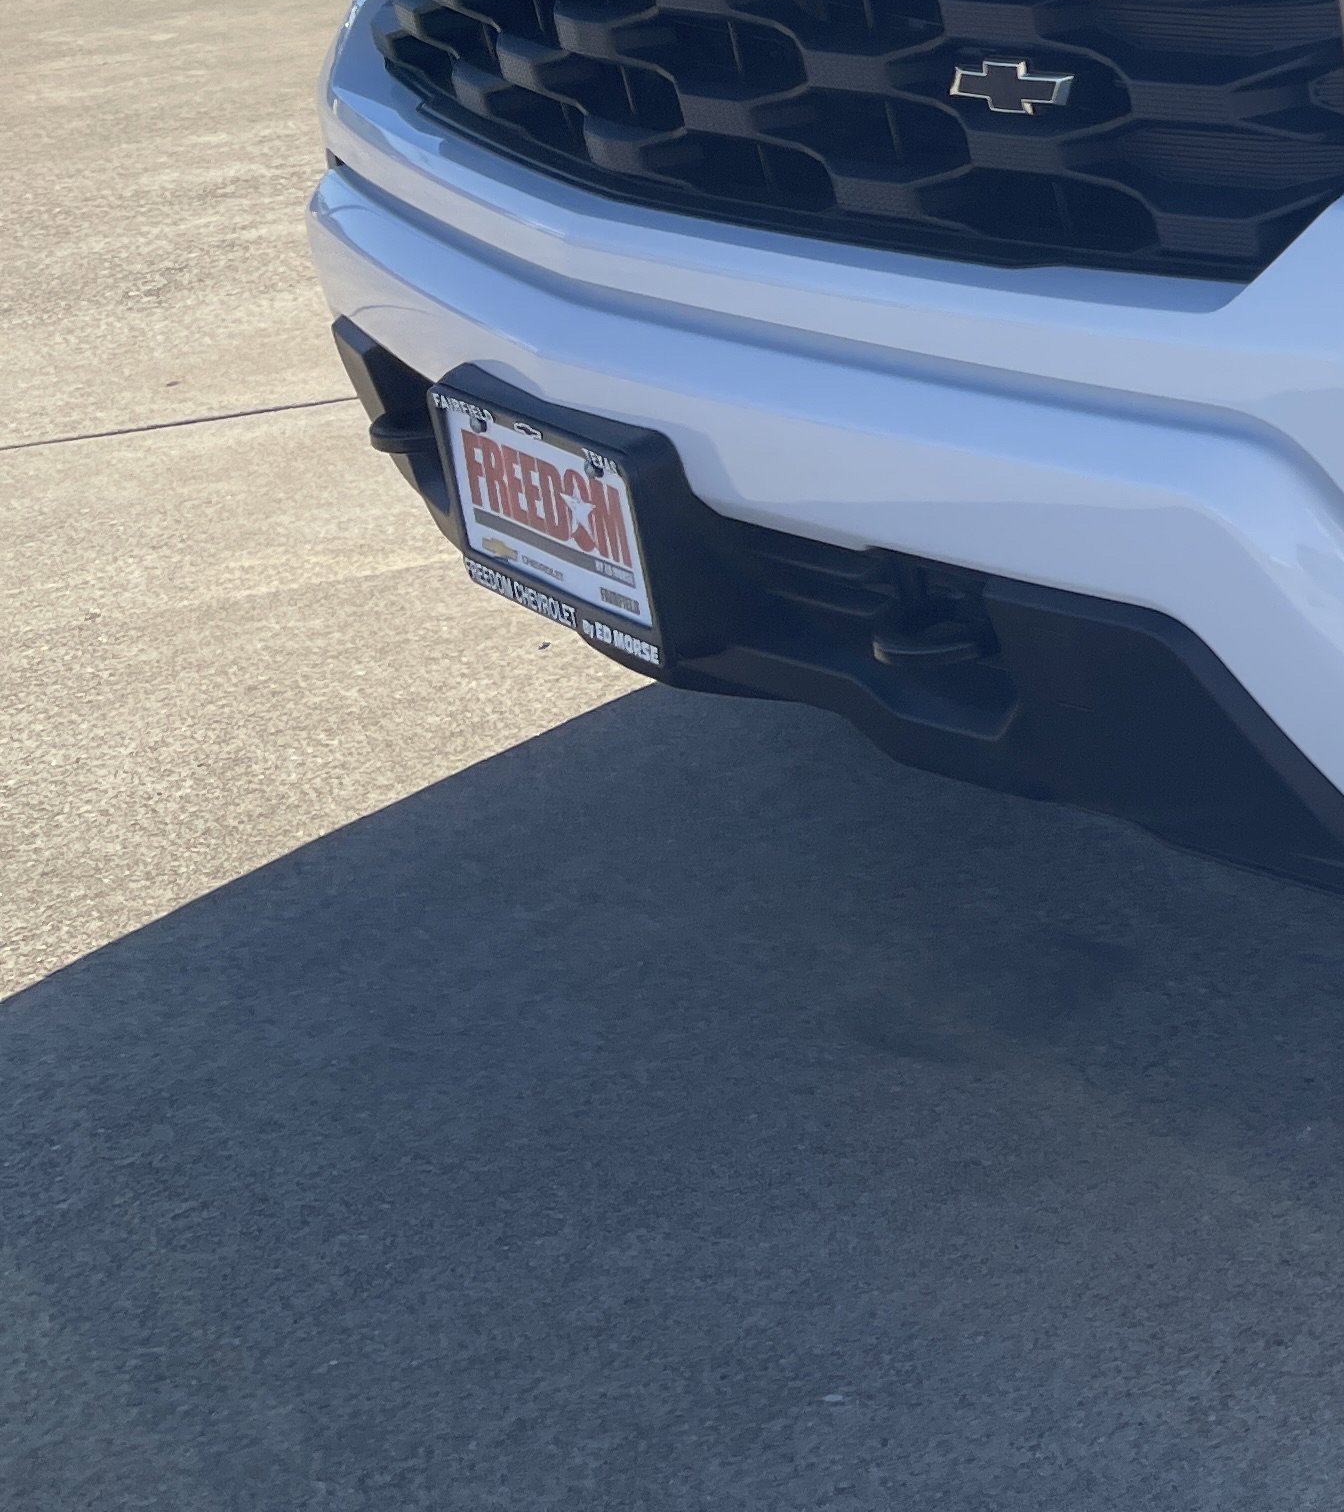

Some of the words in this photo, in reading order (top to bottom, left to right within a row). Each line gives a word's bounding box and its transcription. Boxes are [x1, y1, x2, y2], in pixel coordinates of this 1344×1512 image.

[431, 392, 494, 424] FAIRFIELD
[461, 428, 633, 569] FREEDOM
[464, 556, 514, 599] FREEDOM
[513, 581, 579, 629] CHEVROLET
[595, 621, 612, 644] ED
[613, 629, 661, 665] MORSE
